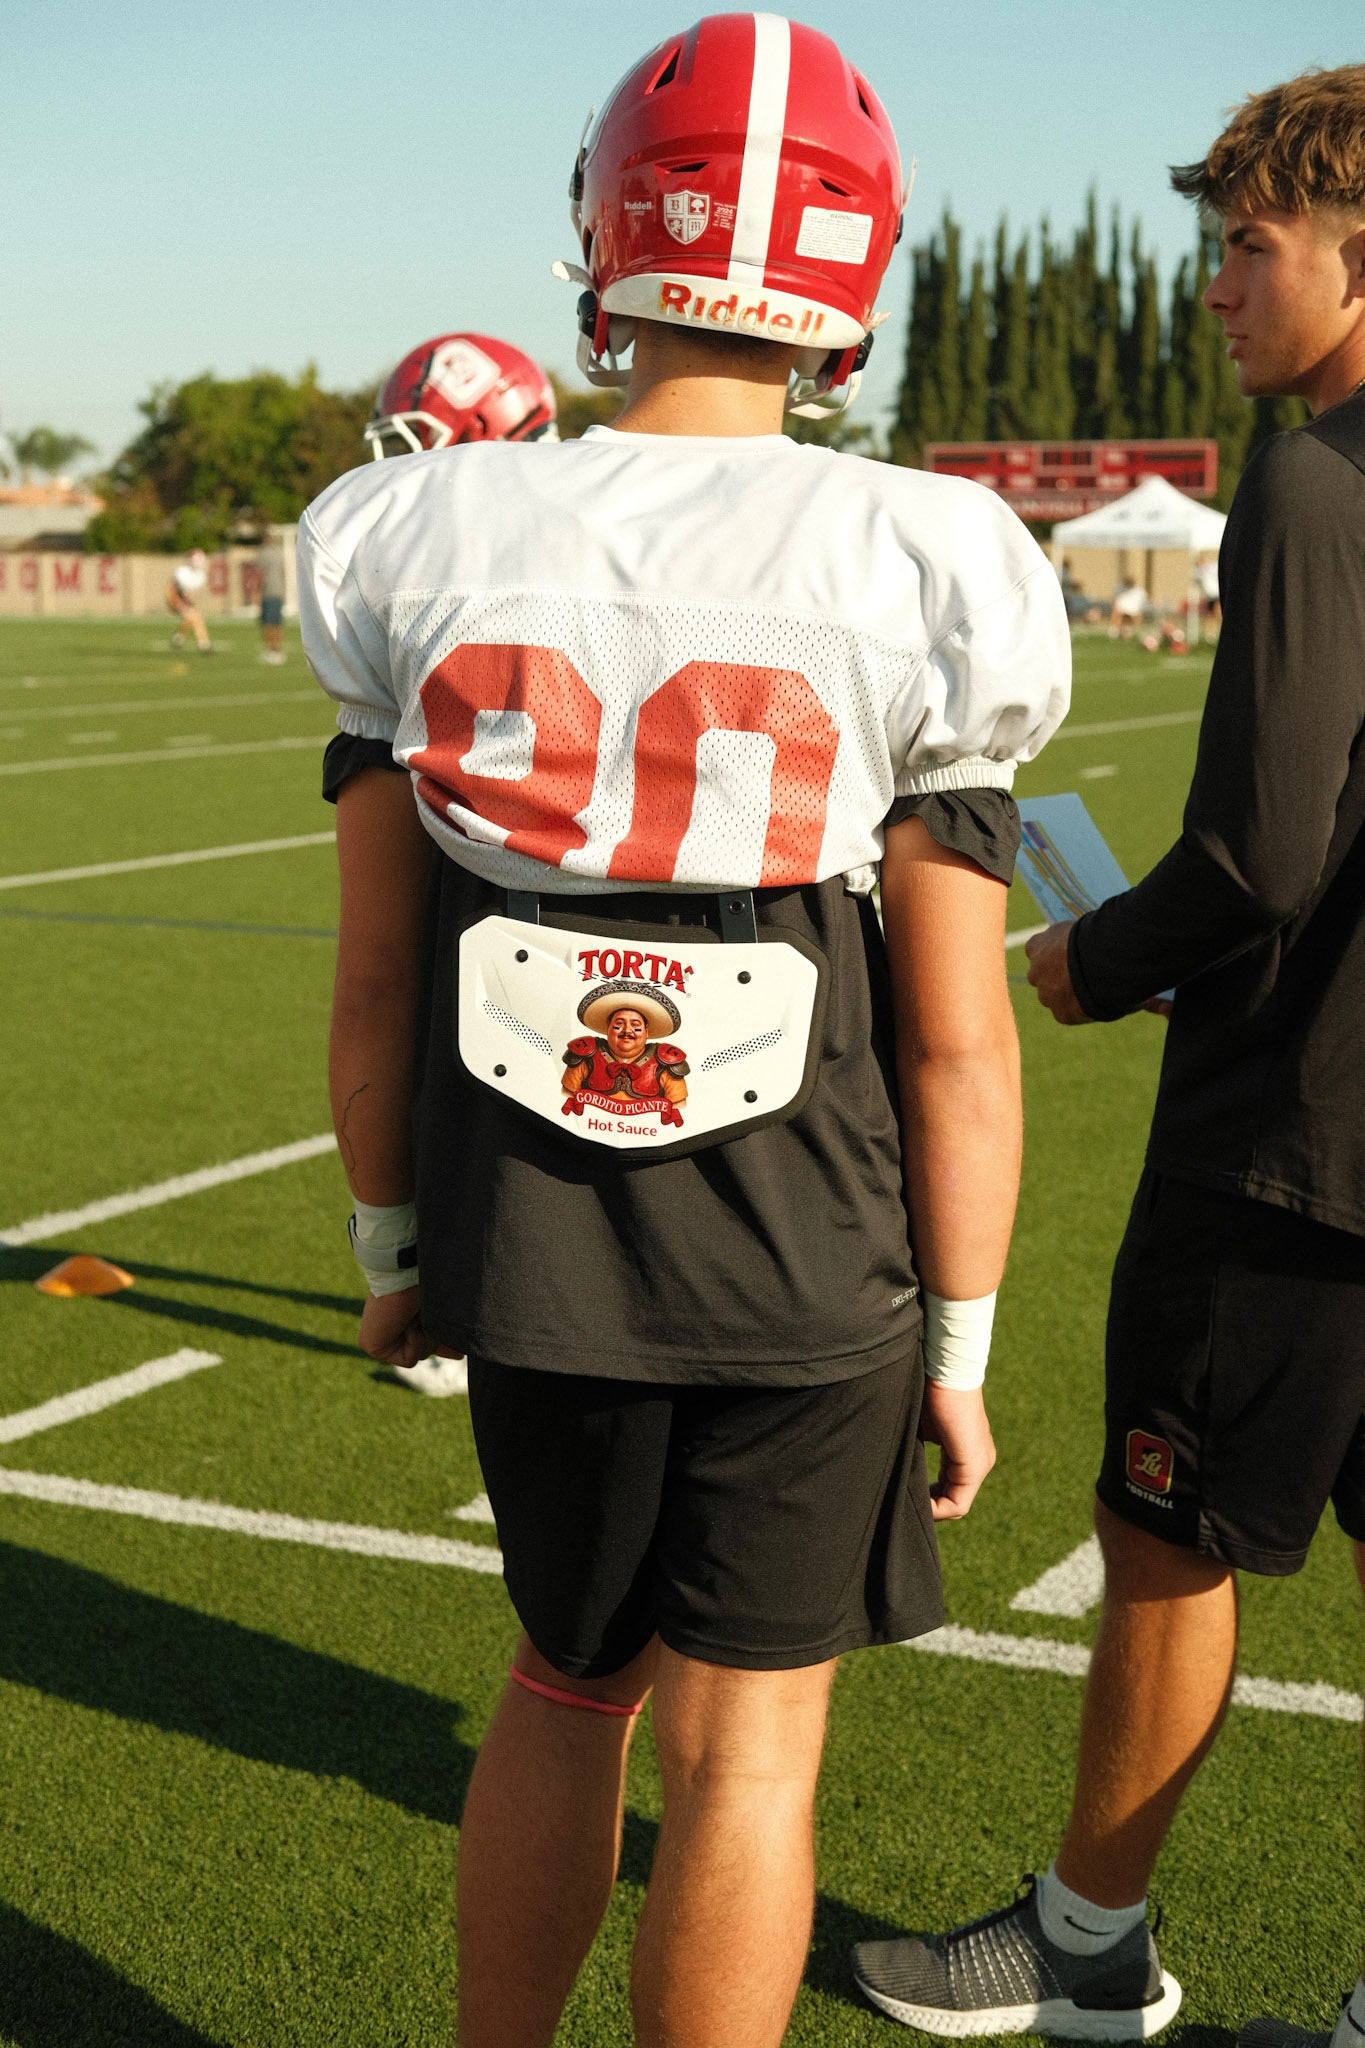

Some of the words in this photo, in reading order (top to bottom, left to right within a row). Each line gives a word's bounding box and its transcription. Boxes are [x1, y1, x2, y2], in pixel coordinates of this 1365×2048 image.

[624, 201, 652, 210] Riddell
[658, 280, 826, 345] Riddell
[0, 554, 116, 594] OME
[577, 948, 686, 993] TORTA
[576, 1092, 622, 1114] GORDITO
[625, 1100, 668, 1114] PICANTE
[588, 1118, 613, 1132] Hot
[617, 1121, 657, 1136] Sauce
